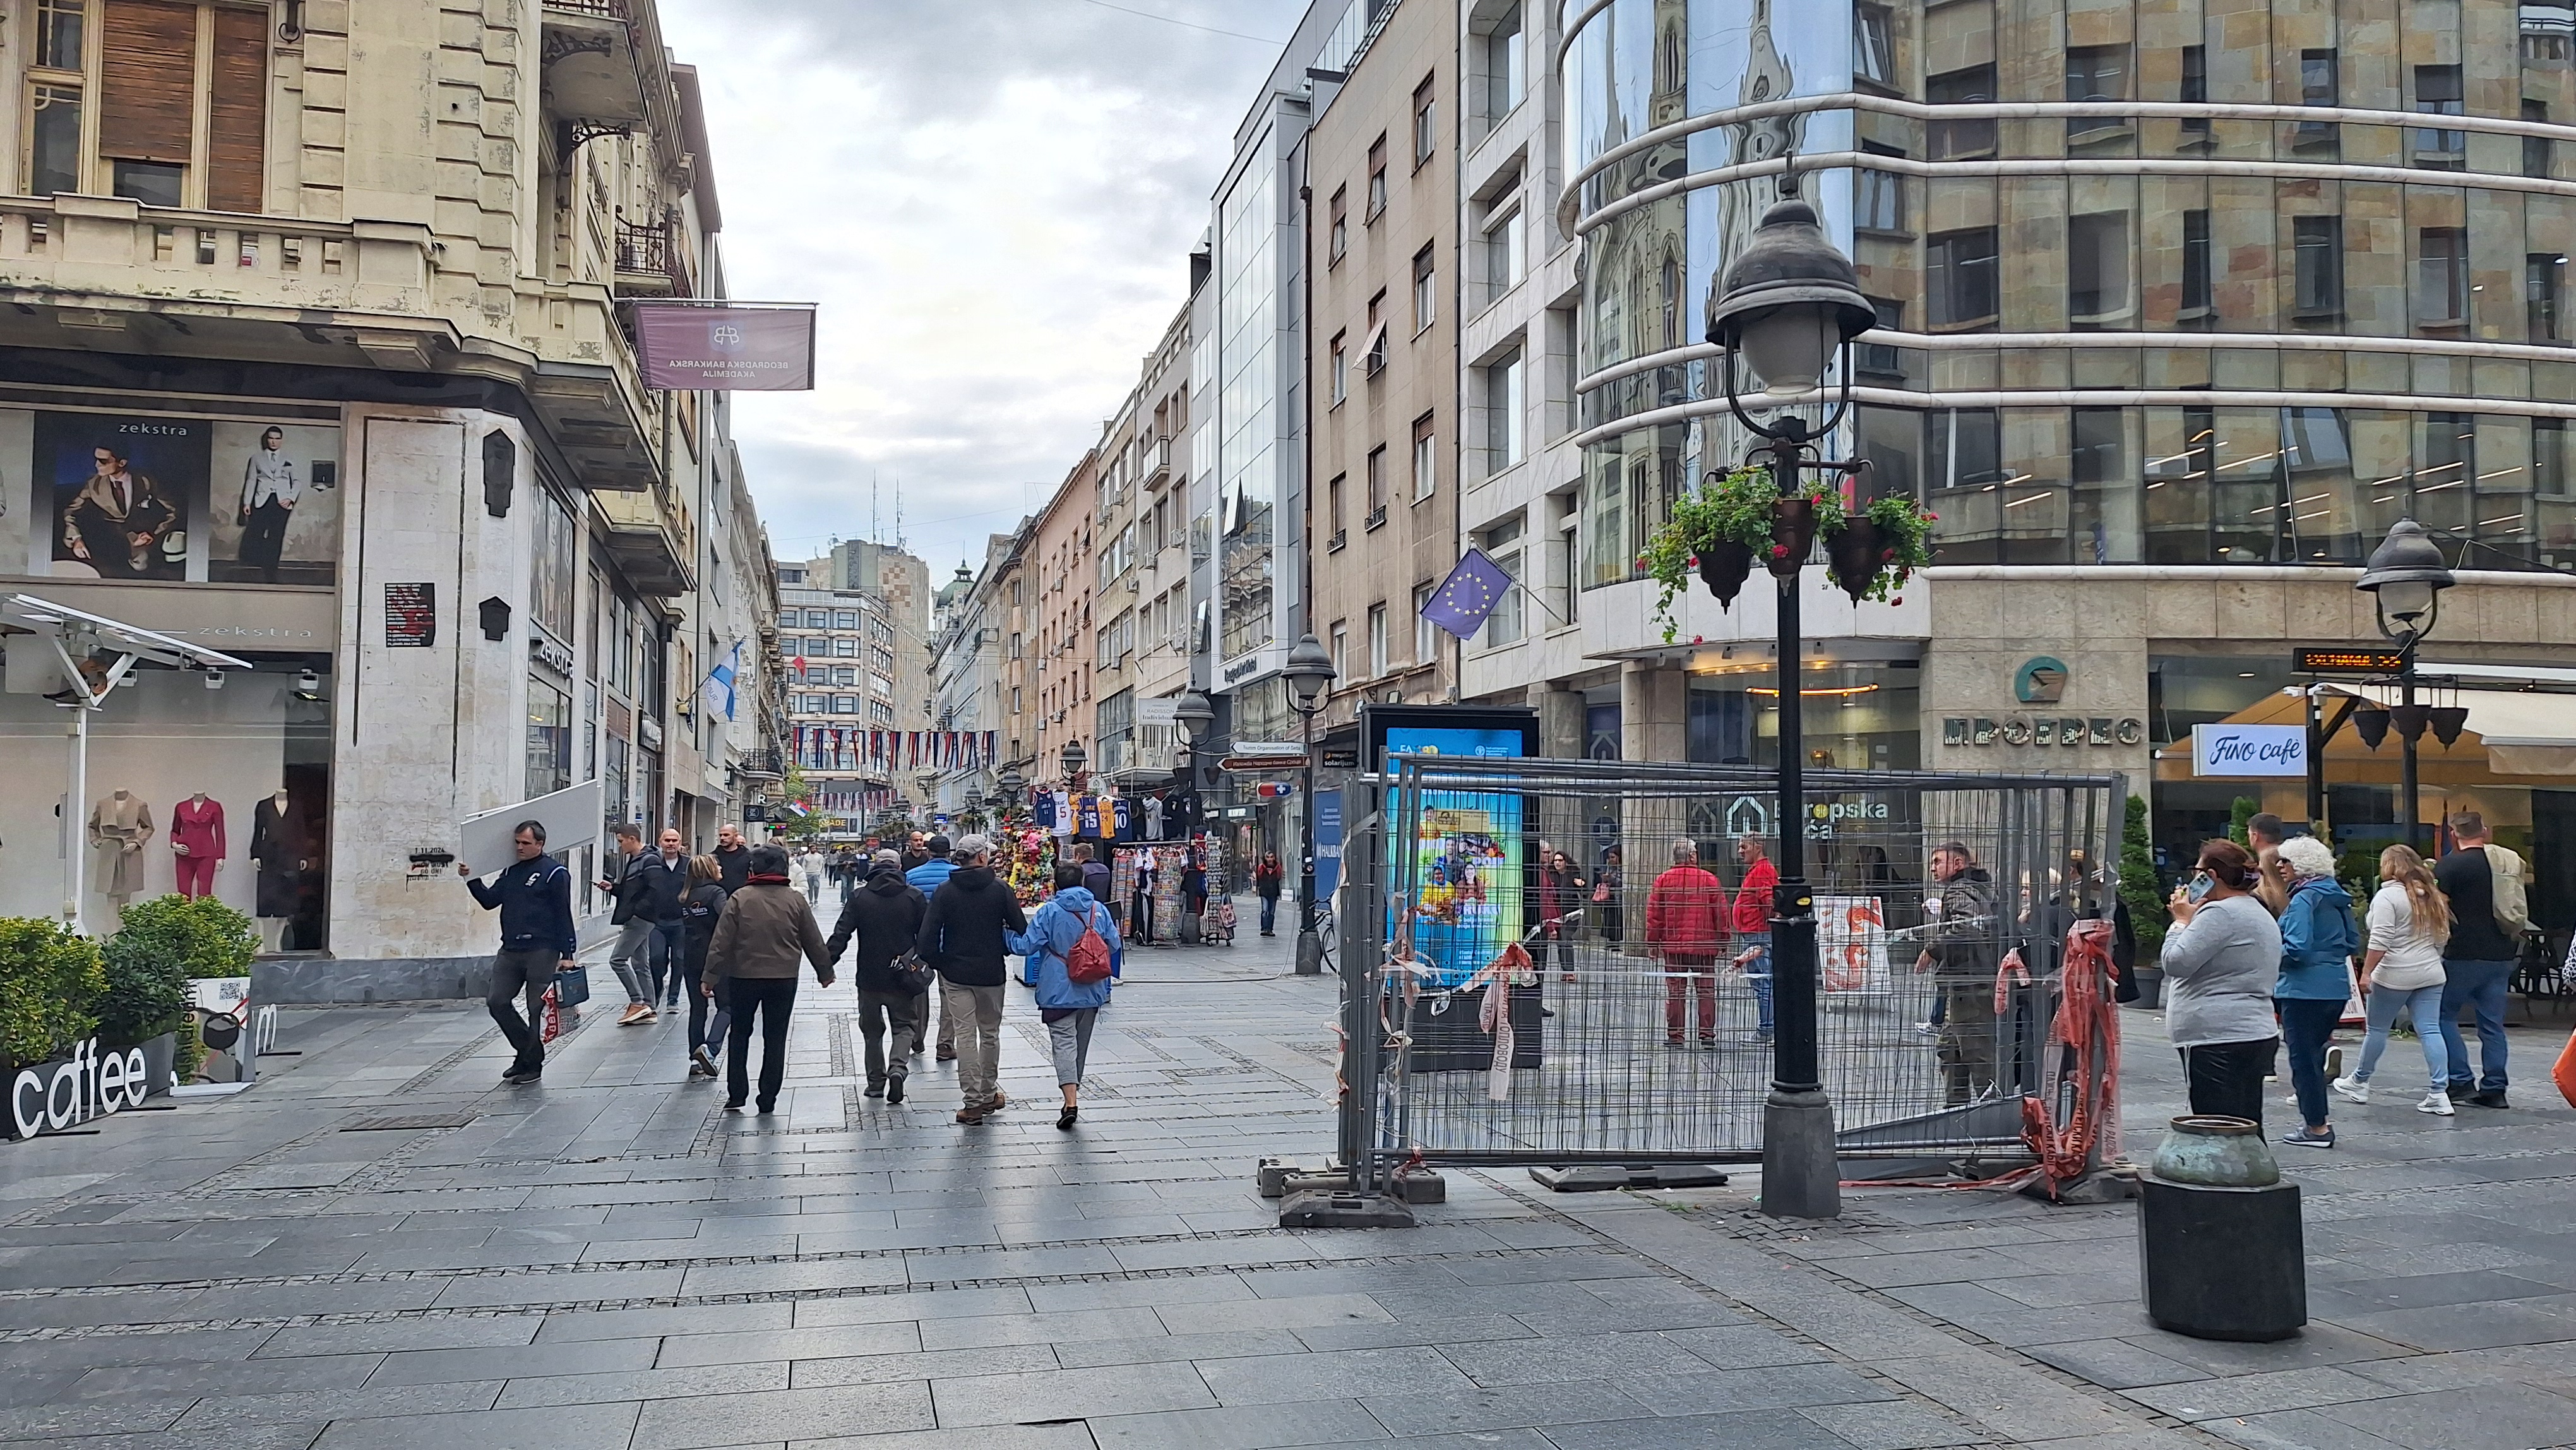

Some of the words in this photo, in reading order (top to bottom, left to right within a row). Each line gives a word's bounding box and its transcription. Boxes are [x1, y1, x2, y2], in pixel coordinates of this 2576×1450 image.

[119, 422, 188, 436] zekstra
[199, 626, 312, 638] zekstra
[540, 637, 573, 678] zekstra
[2210, 735, 2257, 765] FINO
[1114, 813, 1128, 829] 10
[13, 1036, 148, 1139] coffee
